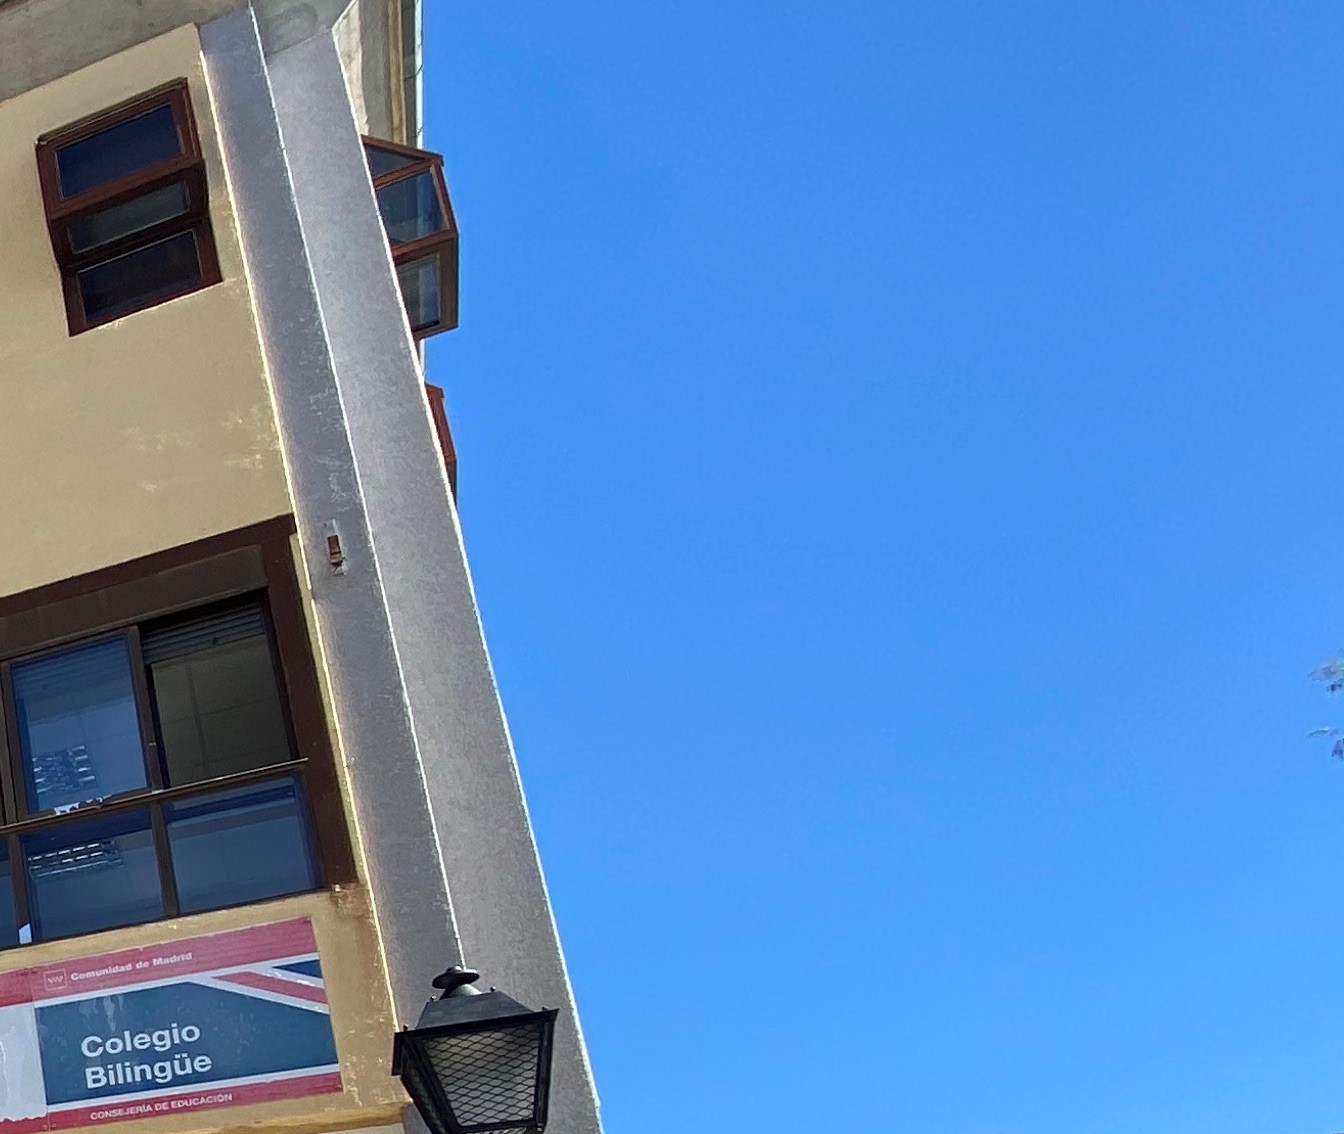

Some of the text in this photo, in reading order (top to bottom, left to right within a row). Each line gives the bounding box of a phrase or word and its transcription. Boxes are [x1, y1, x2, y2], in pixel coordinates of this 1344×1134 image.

[71, 952, 193, 981] Comunidad de Madrid
[81, 1023, 201, 1058] Colegio
[85, 1053, 212, 1089] Bilingüe
[90, 1093, 233, 1120] CONSEJERÍA DE EDUCACIÓN
